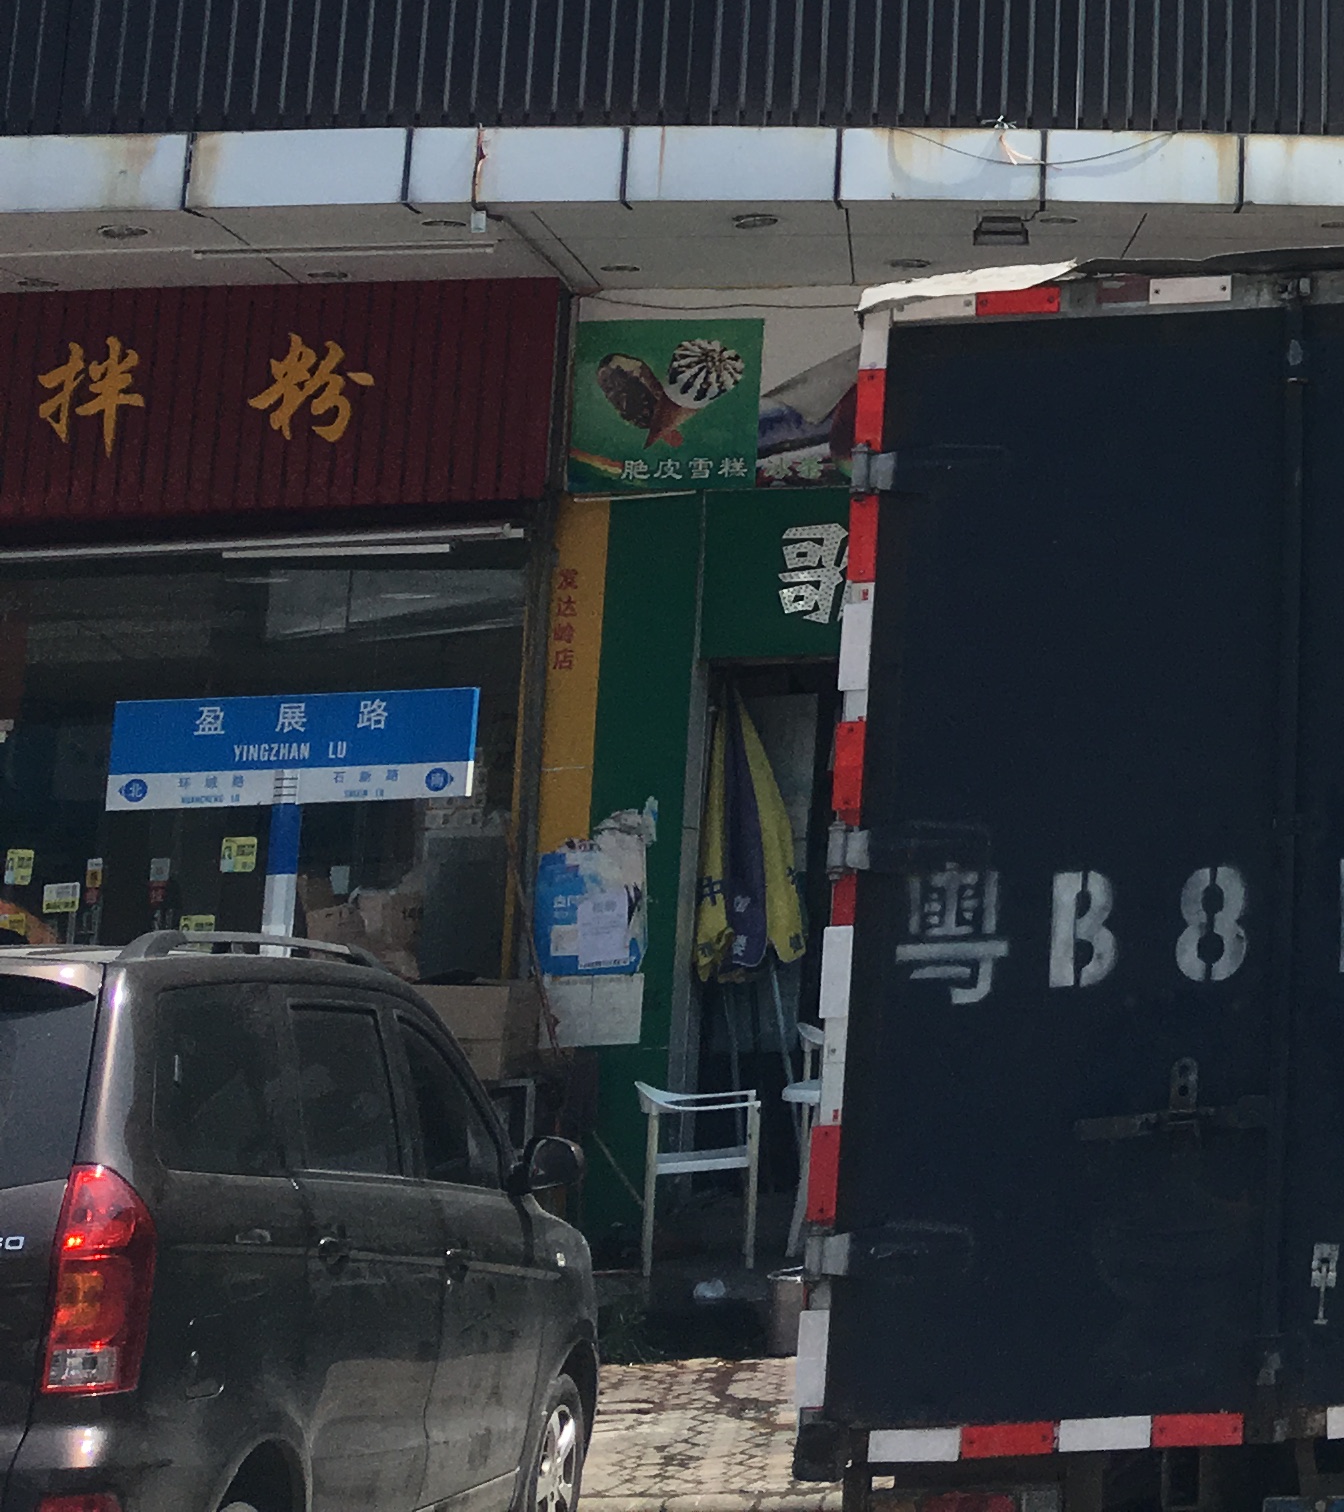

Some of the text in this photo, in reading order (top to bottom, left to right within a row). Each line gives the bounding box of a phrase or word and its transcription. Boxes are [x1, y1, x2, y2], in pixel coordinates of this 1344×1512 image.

[37, 332, 376, 457] 拌粉
[620, 457, 748, 480] 脆皮雪糕
[193, 699, 388, 736] 盈展路
[234, 740, 346, 762] YINGZHAN LU
